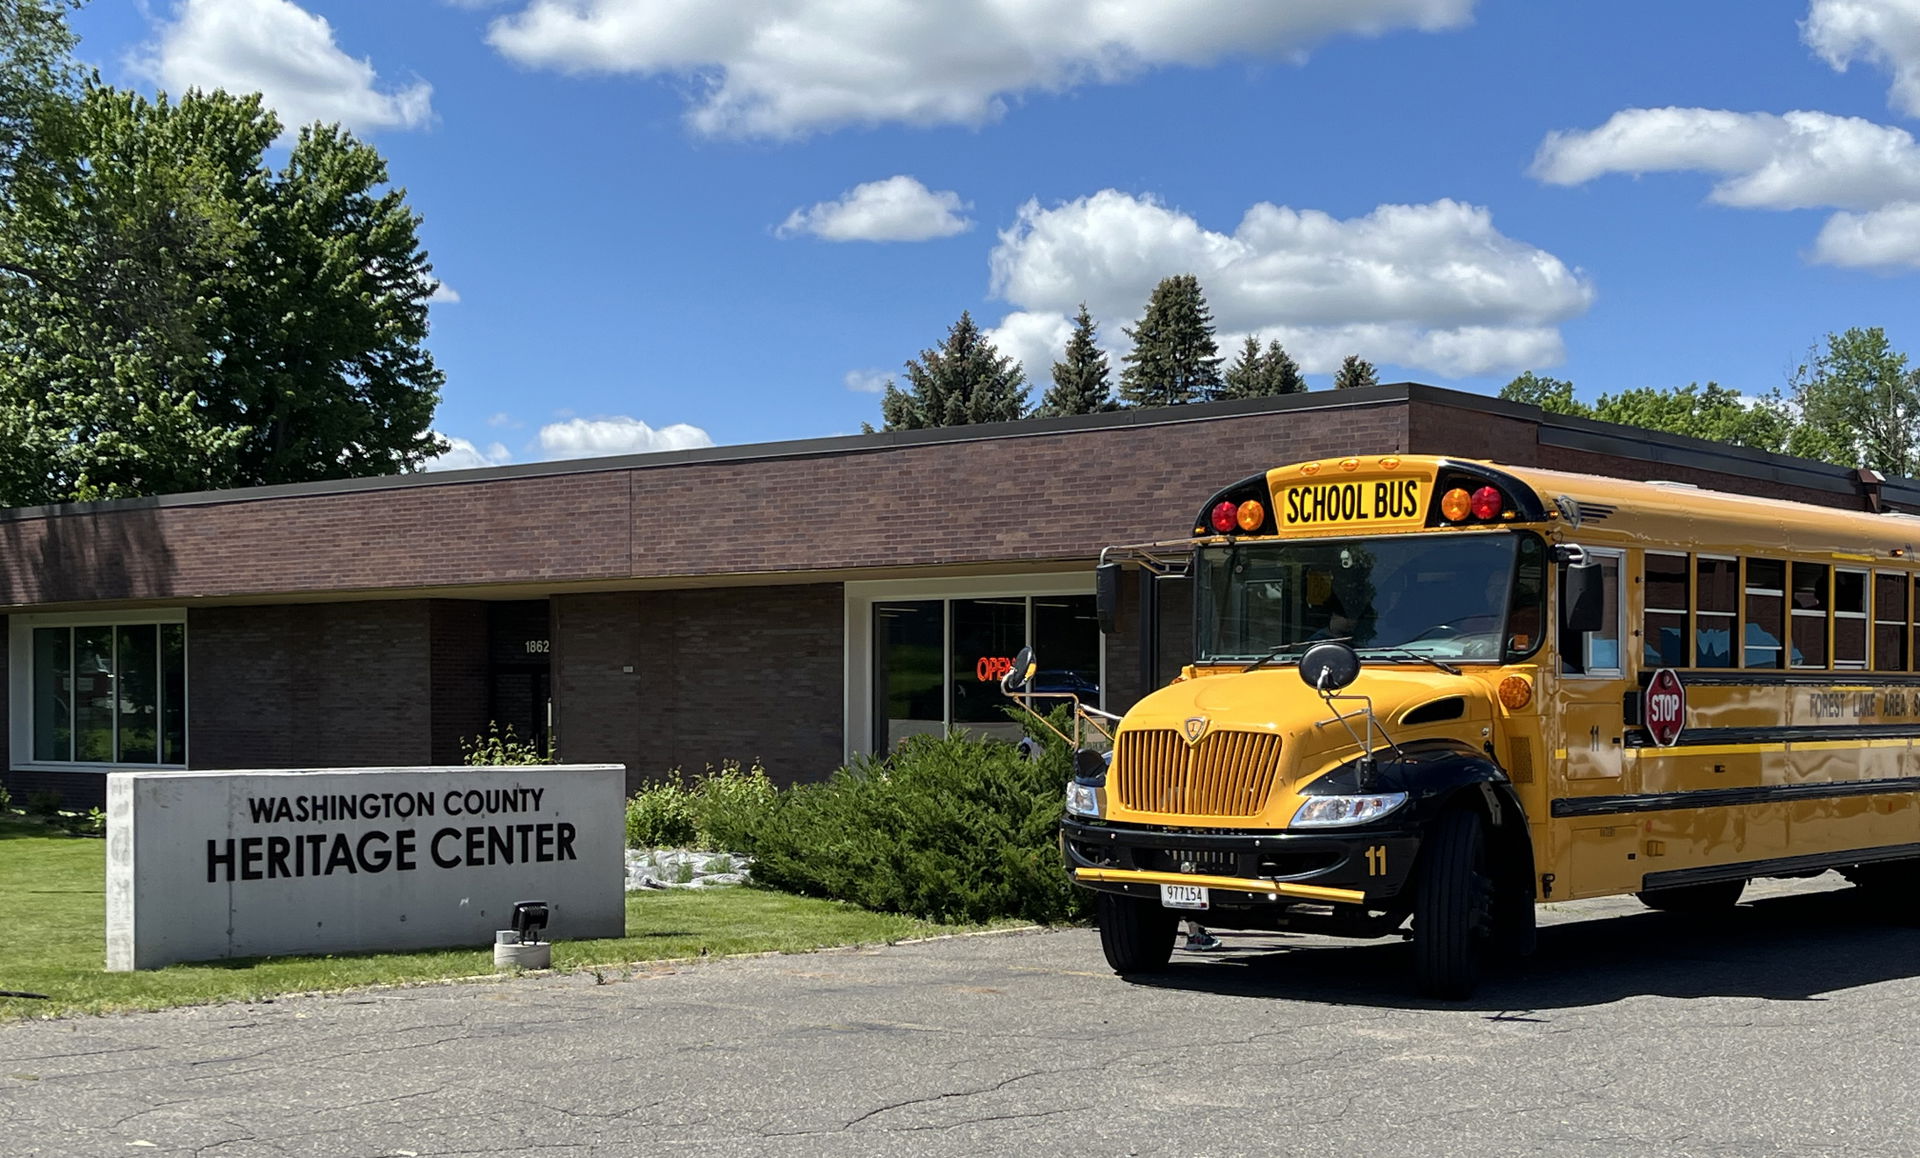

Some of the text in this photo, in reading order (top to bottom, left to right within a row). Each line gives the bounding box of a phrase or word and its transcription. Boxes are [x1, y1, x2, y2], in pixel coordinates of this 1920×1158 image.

[1287, 480, 1418, 524] SCHOOL BUS
[525, 640, 550, 653] 1862
[1651, 694, 1679, 722] STOP
[1809, 693, 1845, 717] FOREST
[1853, 692, 1876, 717] LAKE
[1883, 692, 1906, 716] AREA
[1590, 725, 1599, 752] 11
[248, 788, 545, 823] WASHINGTON COUNTY
[207, 822, 577, 883] HERITAGE CENTER
[1365, 845, 1387, 876] 11
[1167, 885, 1202, 901] 977154
